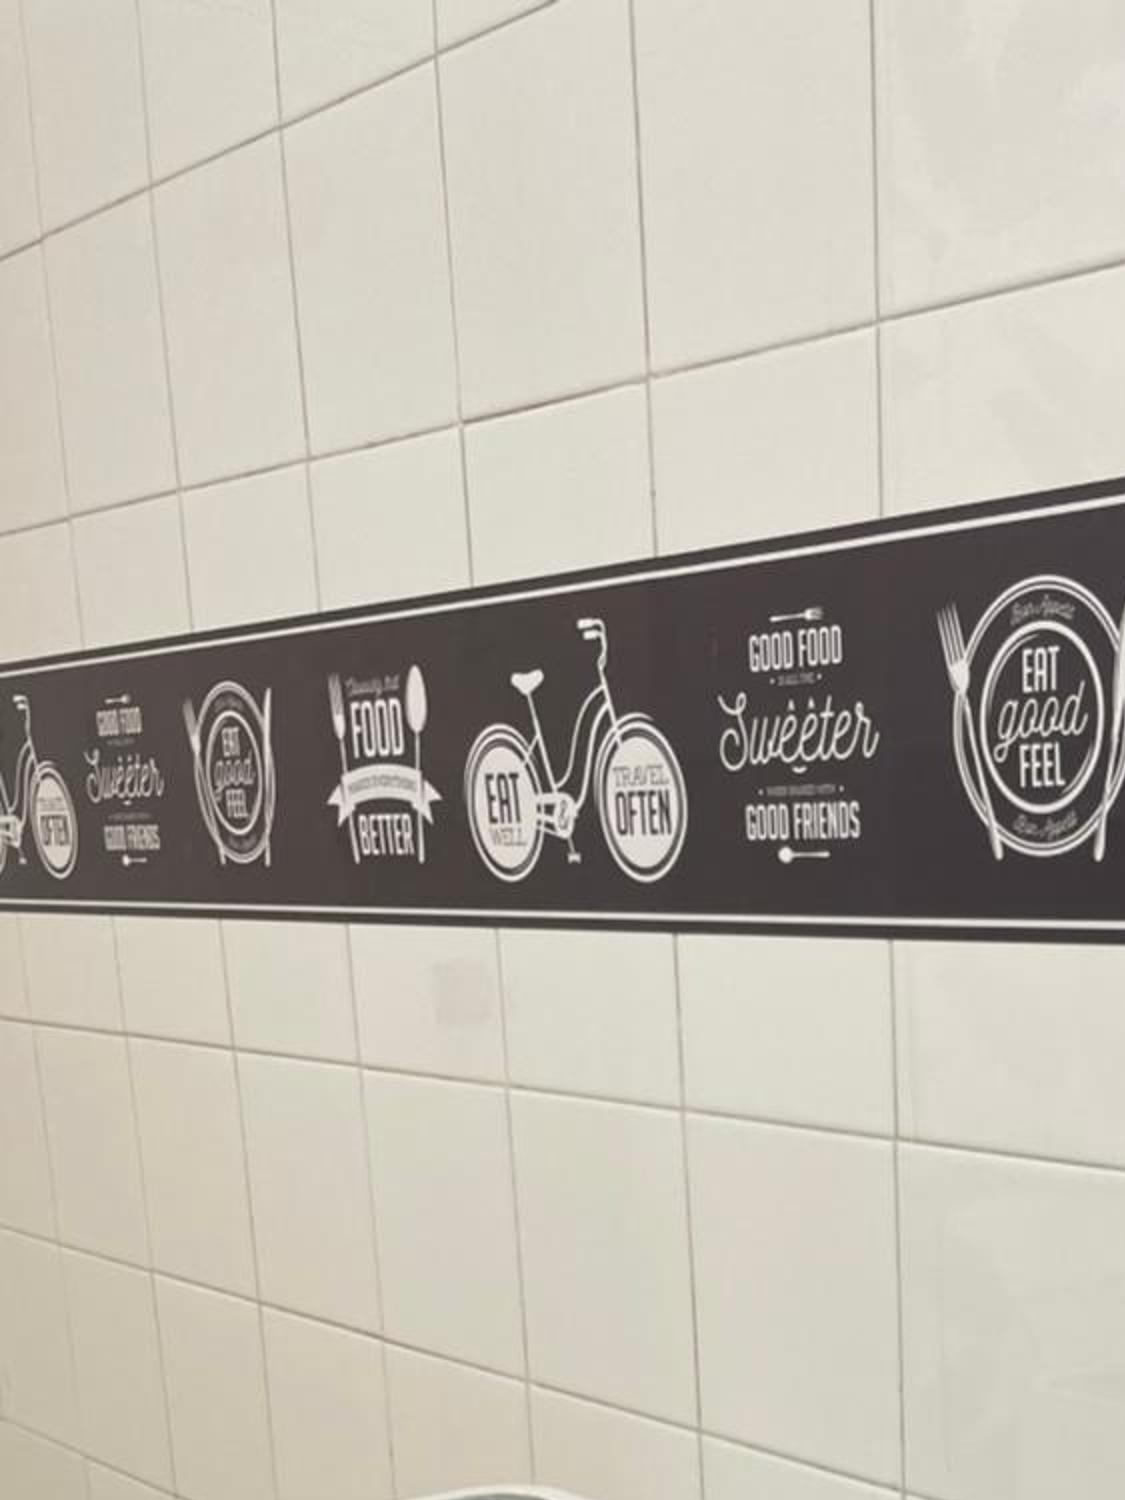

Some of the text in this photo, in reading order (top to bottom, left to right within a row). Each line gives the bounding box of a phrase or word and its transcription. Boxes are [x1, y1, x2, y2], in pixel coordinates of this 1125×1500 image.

[749, 624, 843, 672] GOOD FOOD
[1022, 646, 1061, 693] EAT
[350, 698, 405, 759] FOOD
[993, 680, 1089, 764] good
[1019, 742, 1066, 788] FEEL
[485, 772, 522, 824] EAT
[615, 790, 673, 836] OFTEN
[745, 800, 860, 841] GOOD FRIENDS
[358, 813, 414, 856] BETTER
